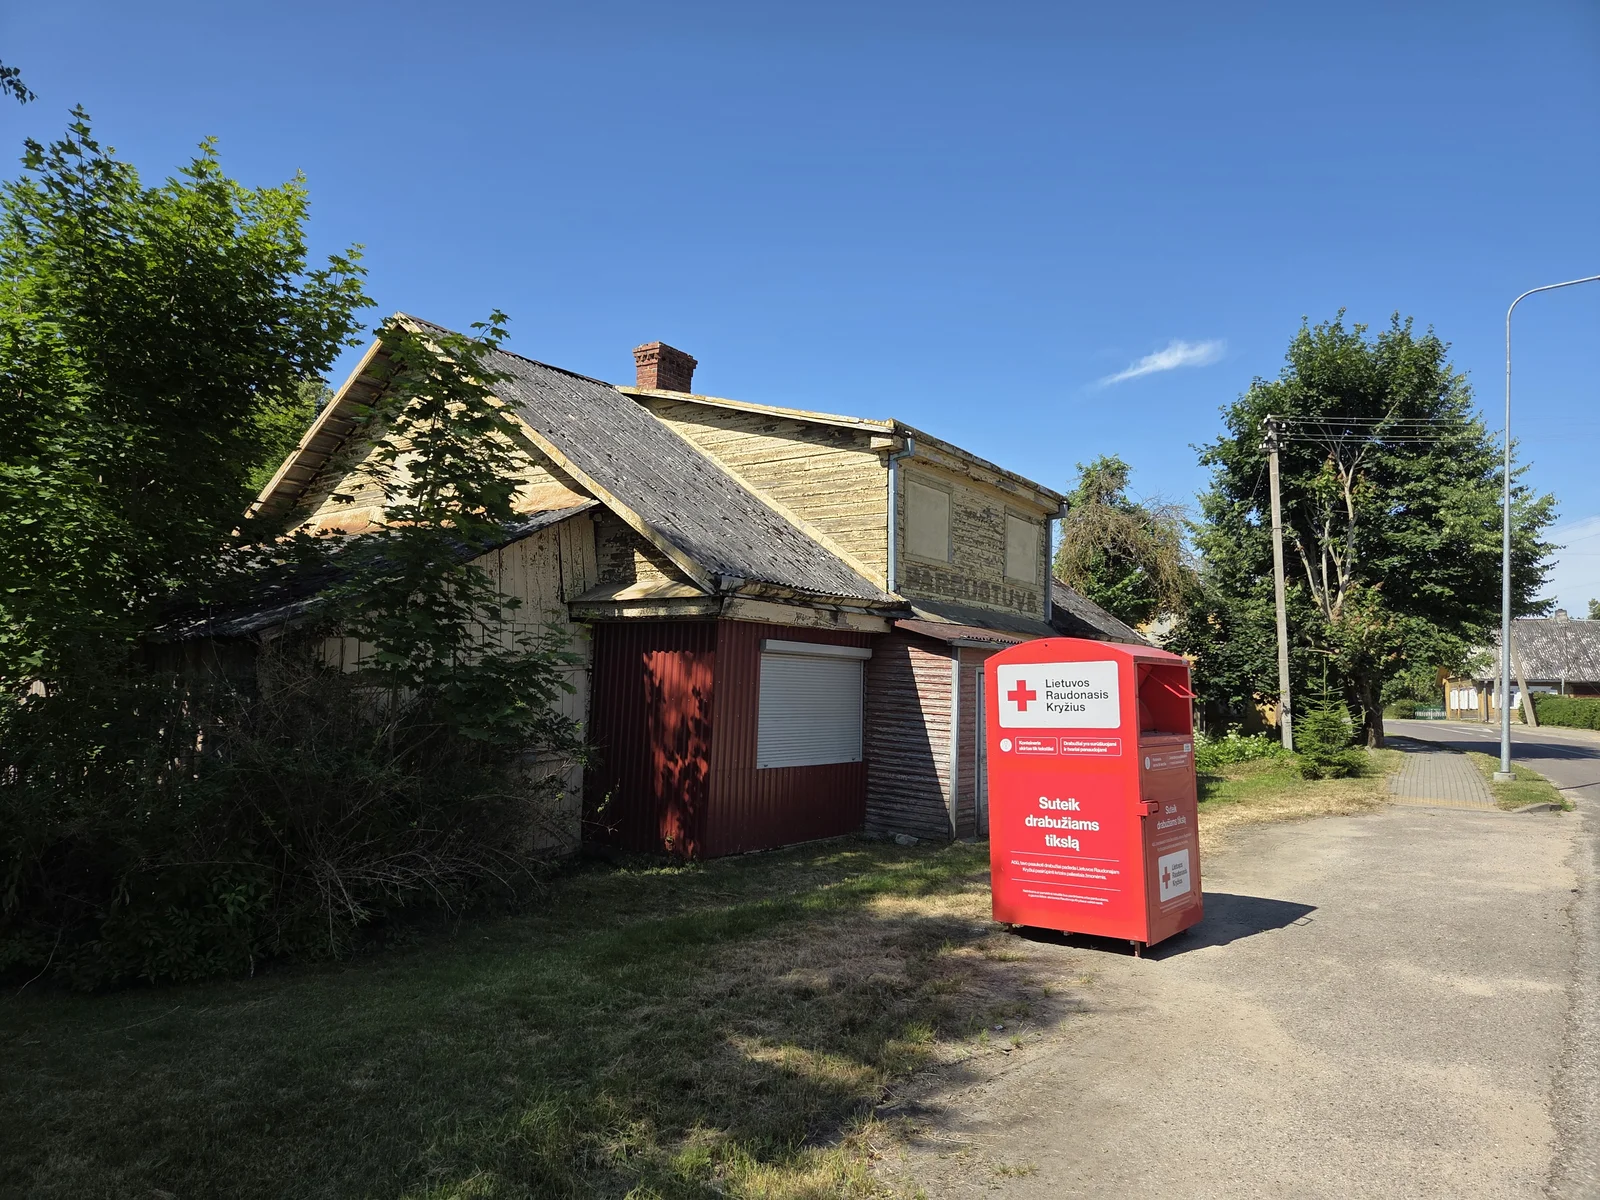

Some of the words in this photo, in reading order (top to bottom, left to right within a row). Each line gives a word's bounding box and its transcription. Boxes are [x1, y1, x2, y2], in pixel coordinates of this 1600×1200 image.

[1045, 679, 1090, 688] Lietuvos
[1046, 690, 1109, 700] Raudonasis
[1046, 702, 1086, 713] Kryžius
[1039, 797, 1080, 811] Suteik
[1025, 814, 1099, 831] drabužiams
[1045, 834, 1080, 851] tikslą
